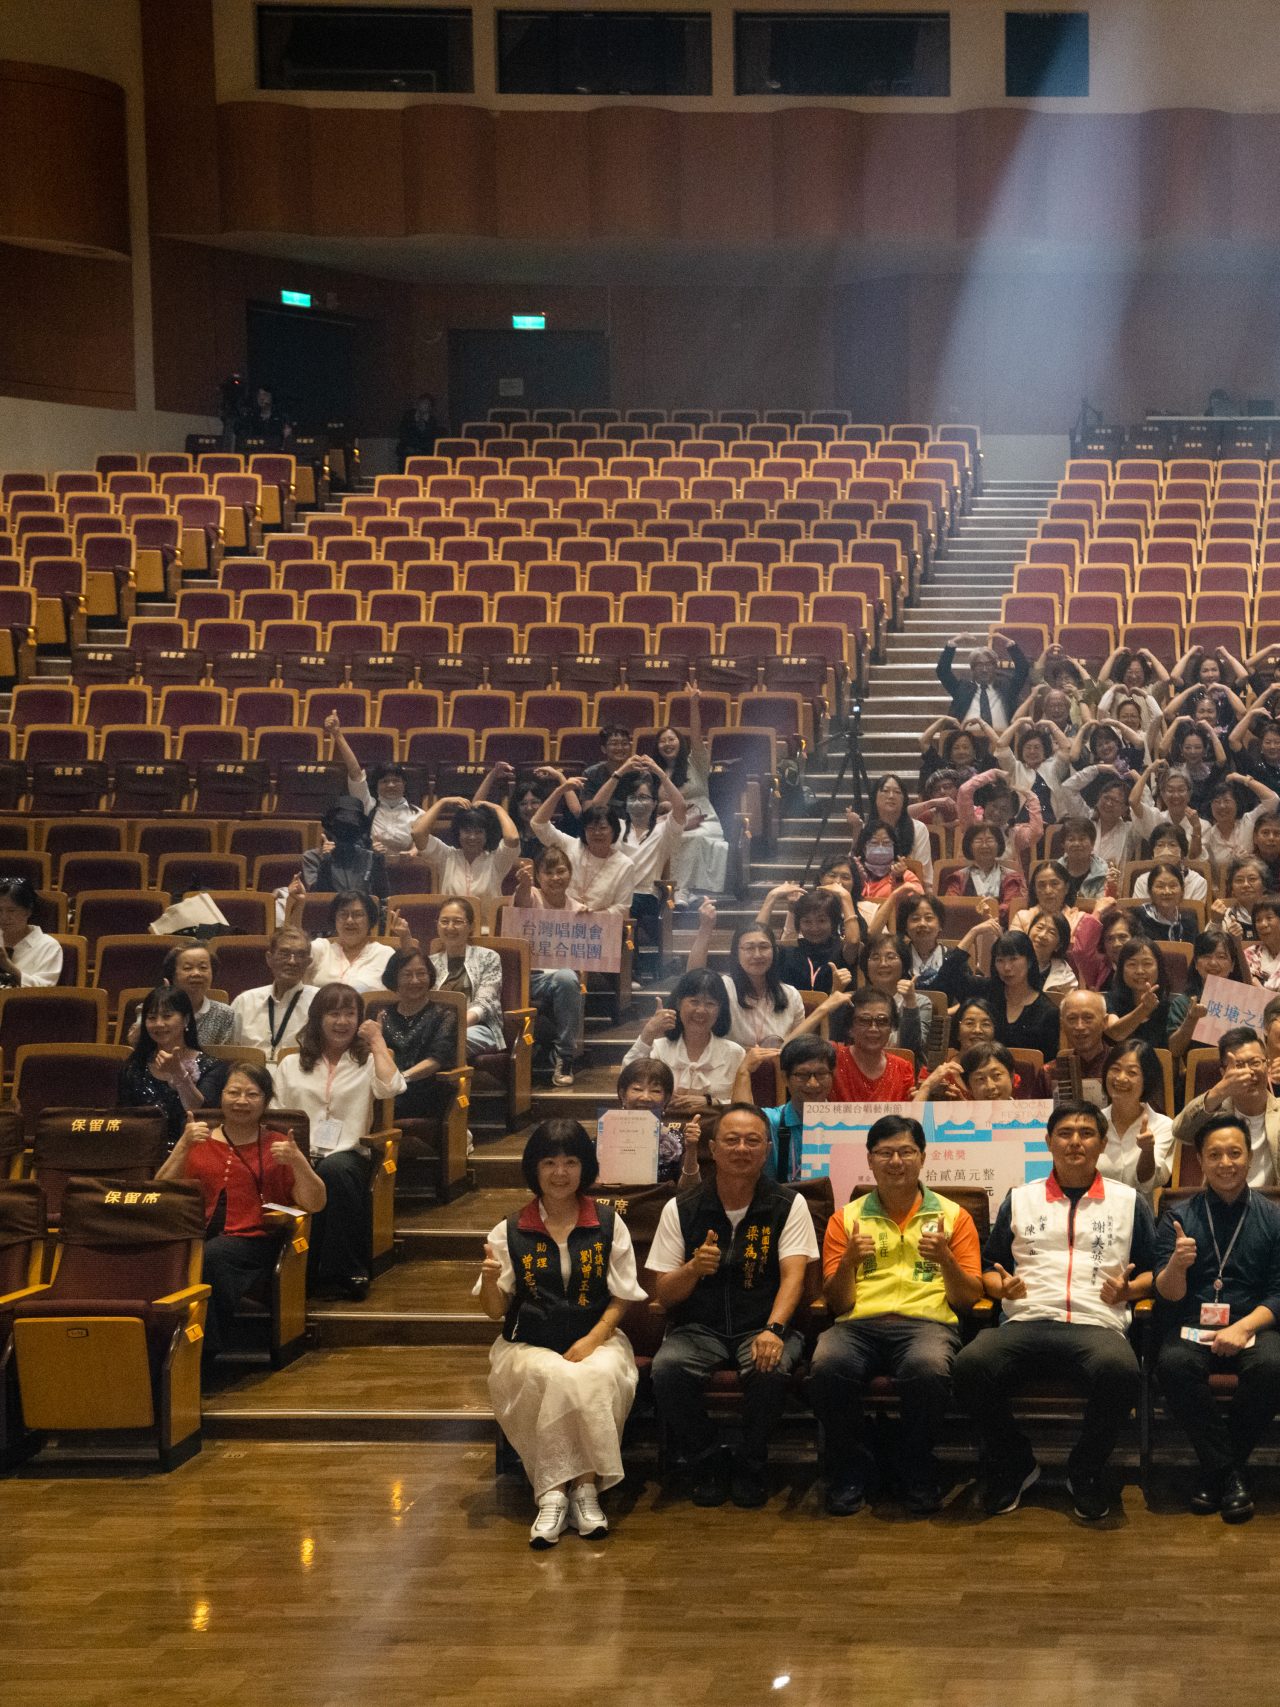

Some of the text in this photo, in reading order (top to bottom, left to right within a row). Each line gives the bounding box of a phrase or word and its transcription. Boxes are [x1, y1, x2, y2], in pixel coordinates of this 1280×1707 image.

[806, 1104, 831, 1114] 2025
[70, 1119, 122, 1132] 保留席
[104, 1190, 161, 1204] 保留席
